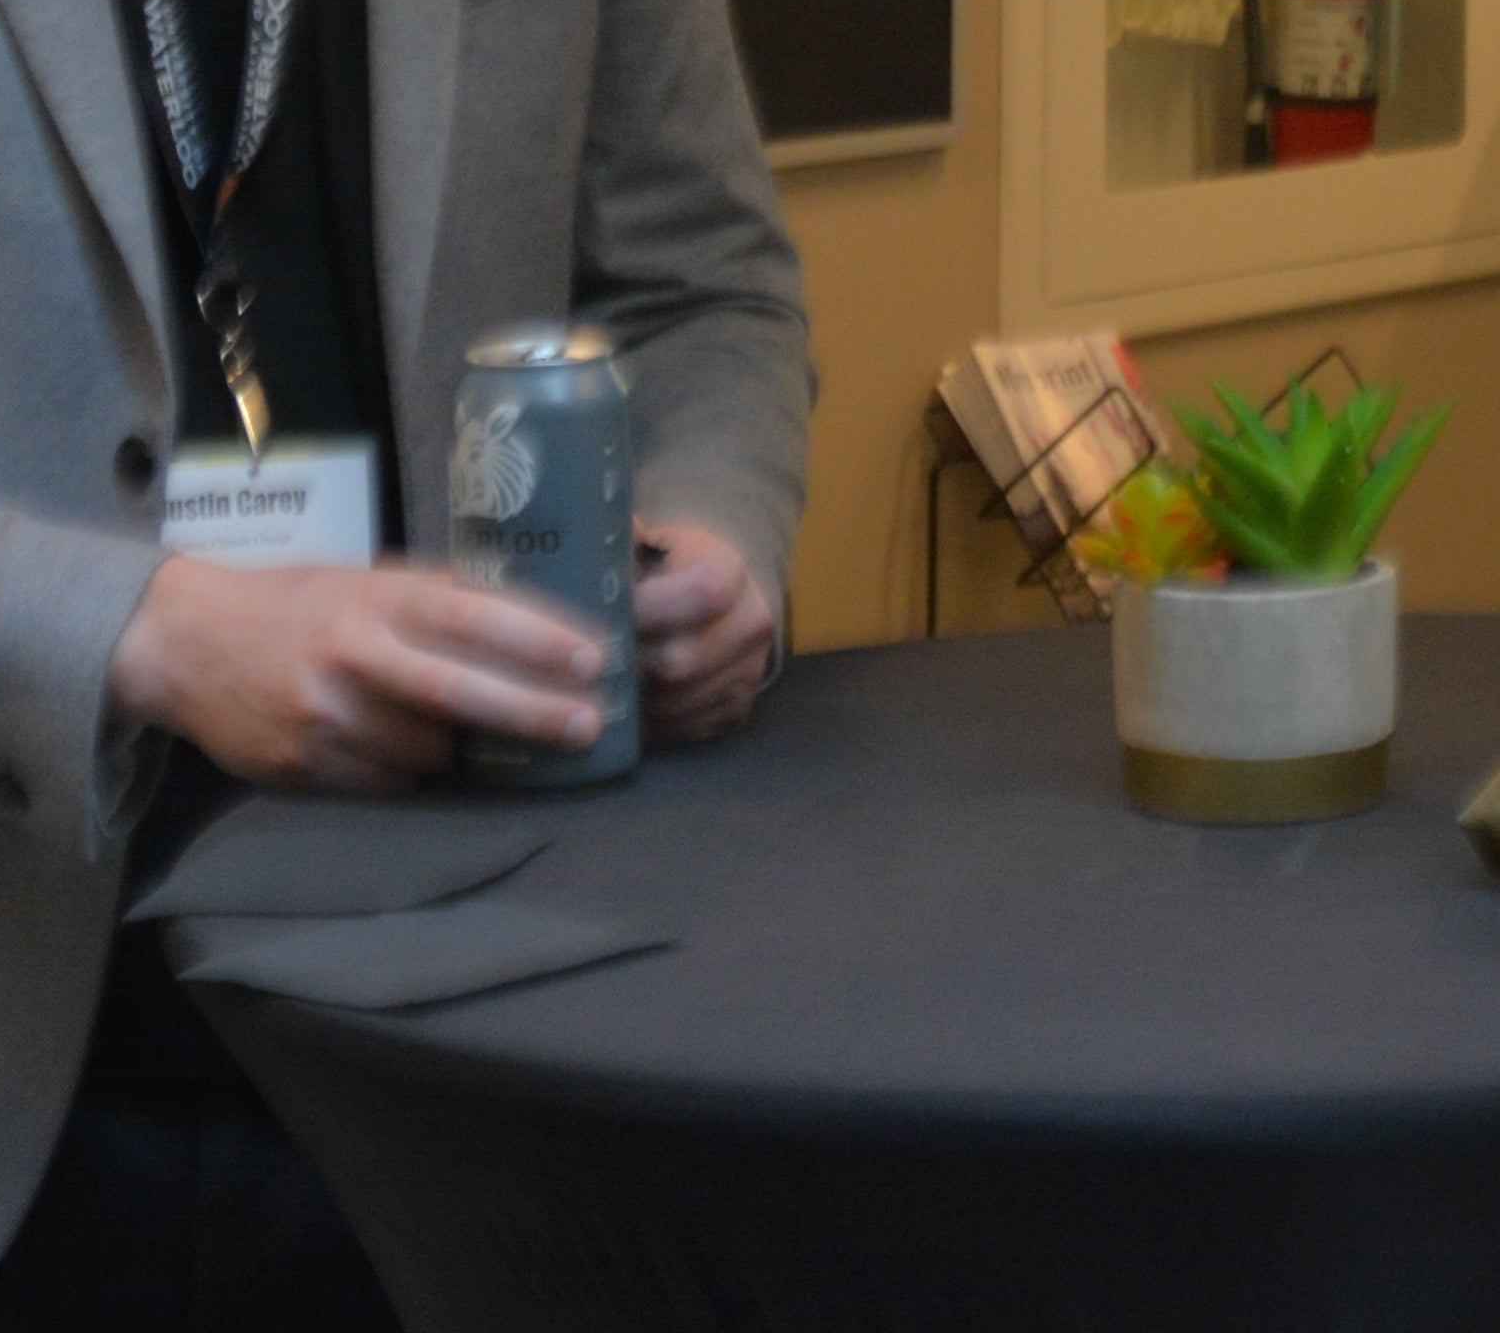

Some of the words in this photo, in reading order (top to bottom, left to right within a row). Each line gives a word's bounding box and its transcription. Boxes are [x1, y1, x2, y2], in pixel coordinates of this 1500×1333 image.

[165, 491, 232, 523] ustin
[236, 486, 307, 517] Carey
[456, 556, 504, 589] ARK
